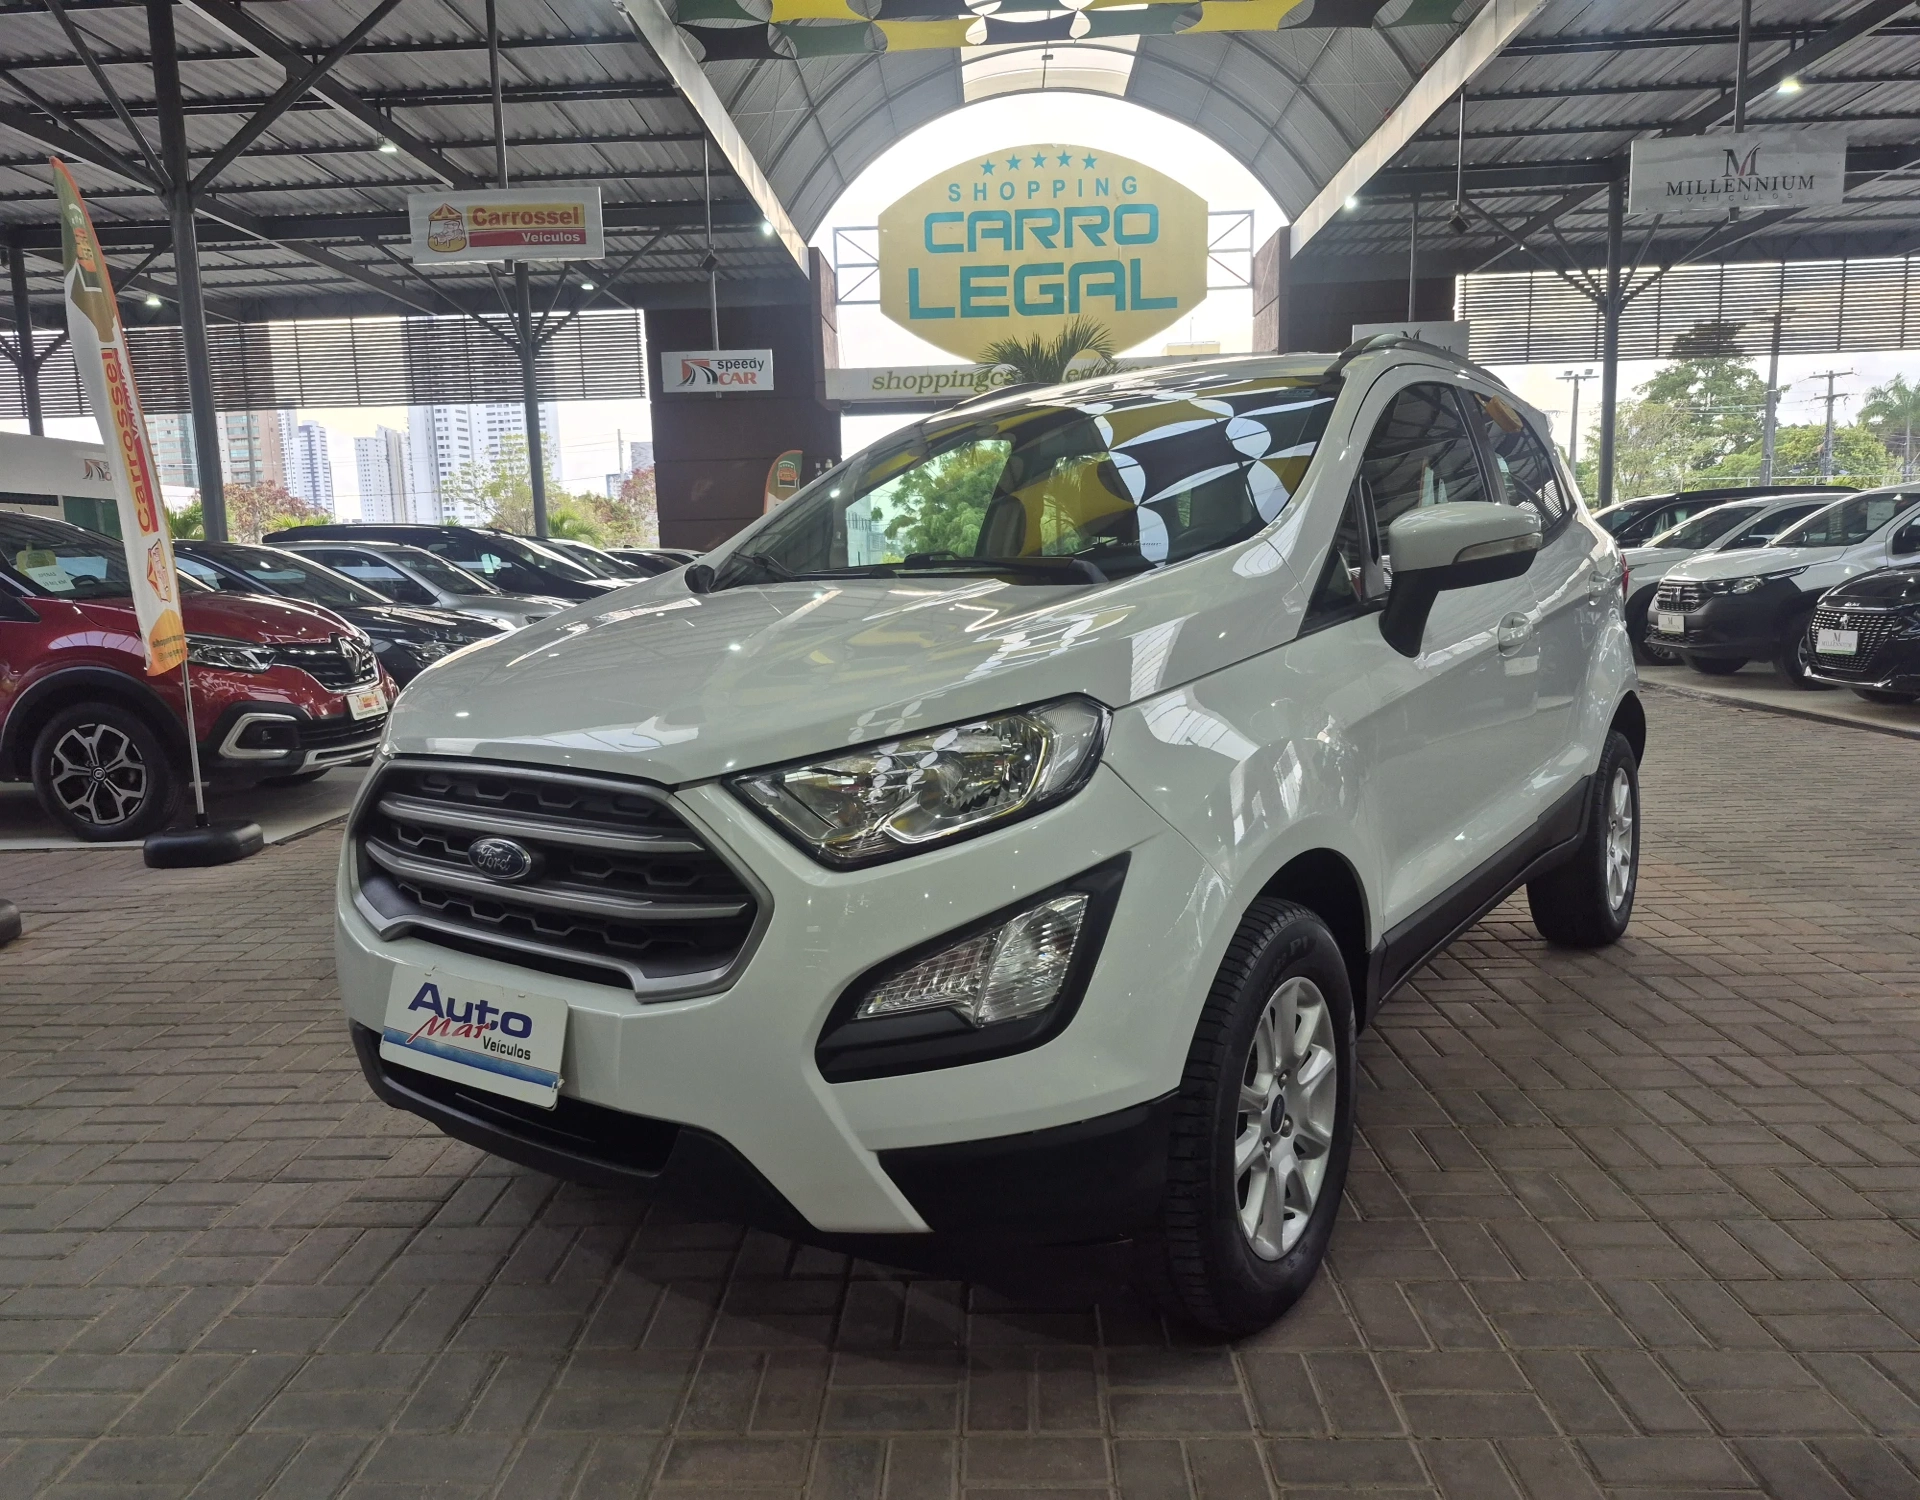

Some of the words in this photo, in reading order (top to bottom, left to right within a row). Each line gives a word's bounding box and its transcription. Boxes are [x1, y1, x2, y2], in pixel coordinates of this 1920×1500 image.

[947, 175, 1138, 202] SHOPPING
[1665, 174, 1816, 197] MILLENNIUM
[472, 206, 579, 227] Carrossel
[924, 203, 1159, 254] CARRO
[908, 258, 1178, 319] LEGAL
[717, 358, 765, 372] speedy
[718, 371, 757, 386] CAR
[102, 352, 150, 532] Carrossel
[477, 844, 512, 871] Ford
[407, 982, 533, 1039] Auto
[405, 1015, 491, 1045] Mar
[482, 1035, 531, 1061] Veículos
